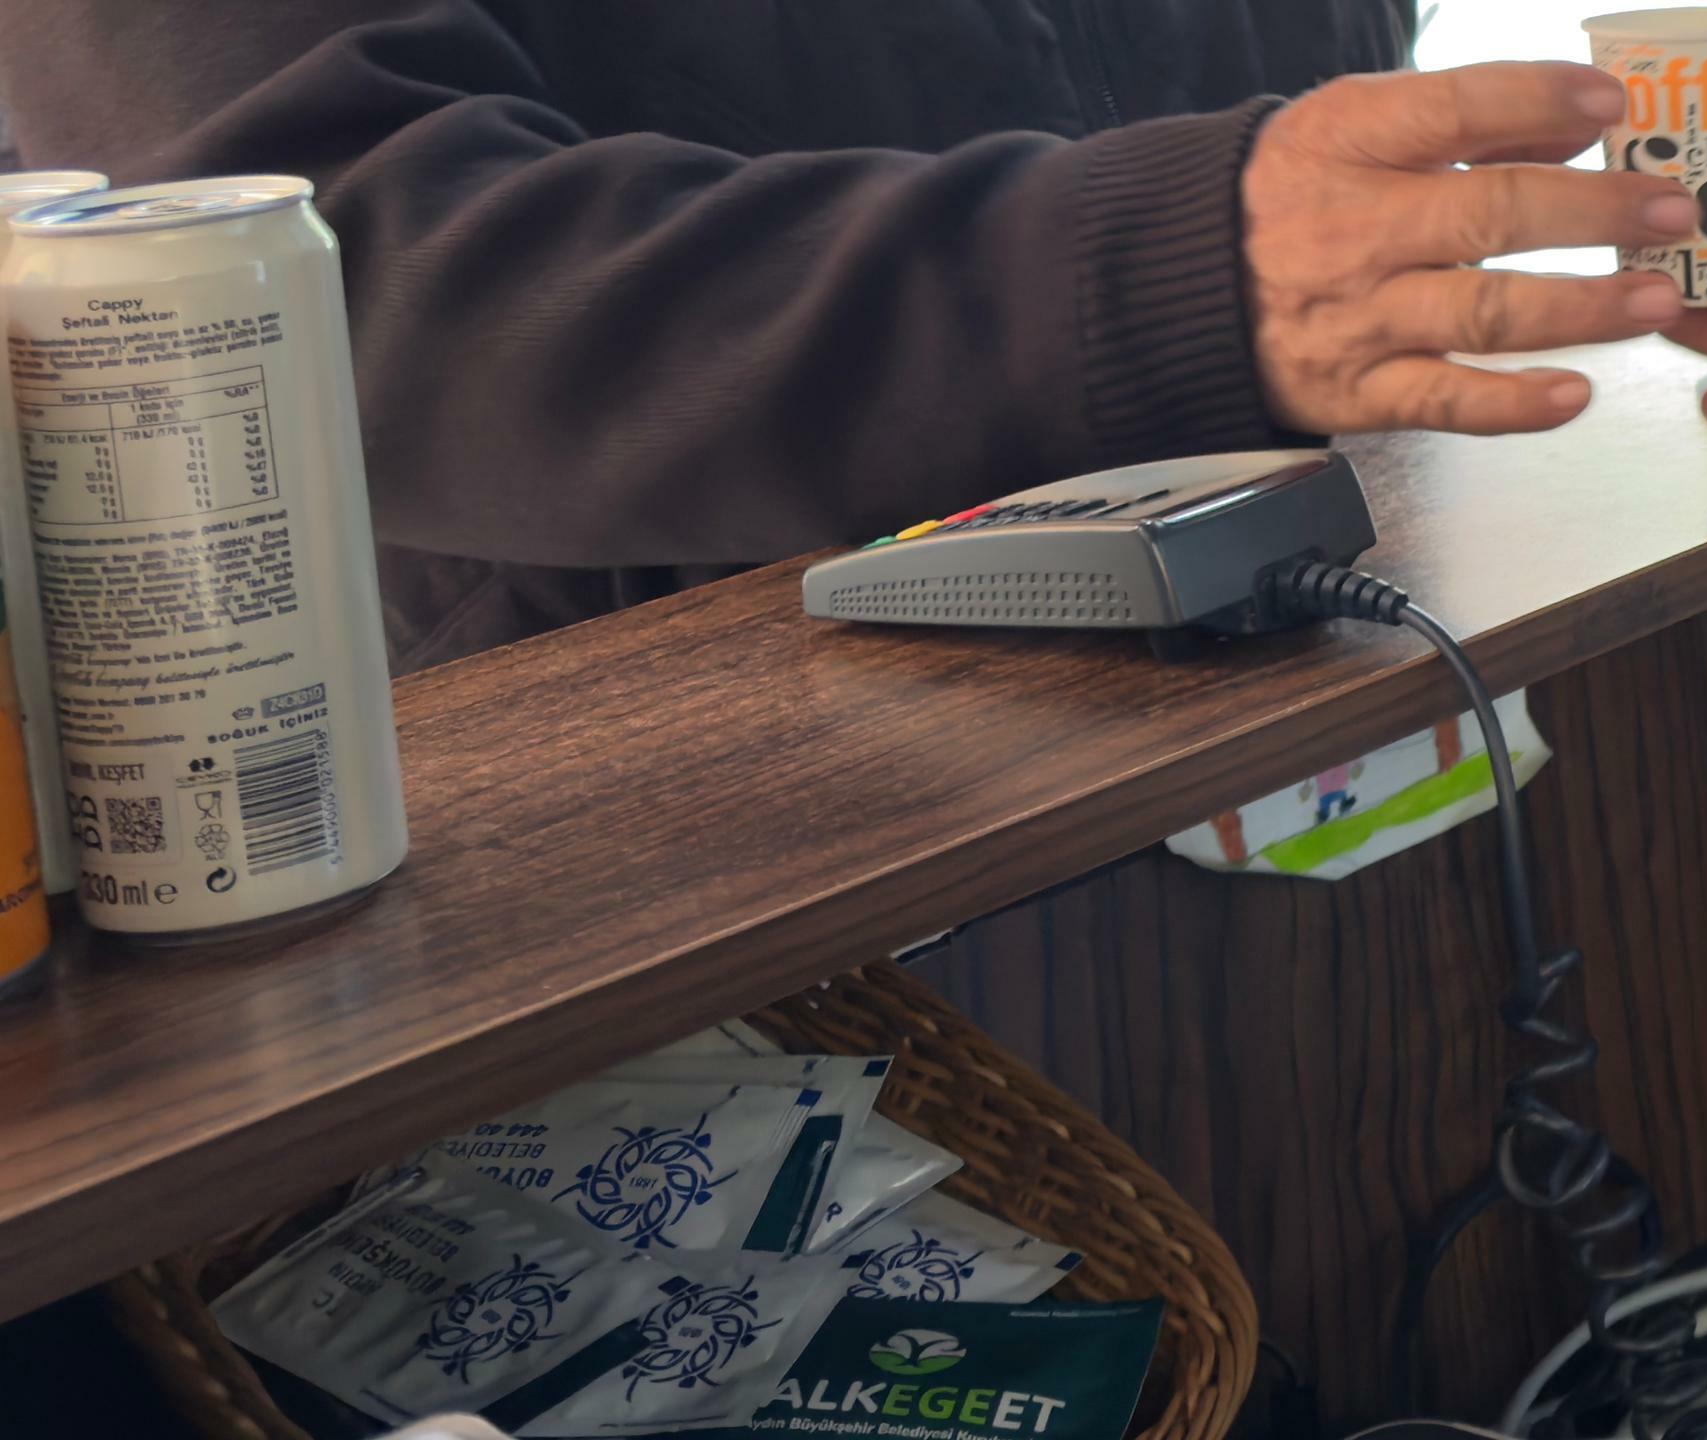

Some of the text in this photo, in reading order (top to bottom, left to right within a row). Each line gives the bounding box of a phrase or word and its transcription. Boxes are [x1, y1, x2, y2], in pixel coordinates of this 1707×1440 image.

[87, 298, 144, 312] Cappy
[758, 1377, 1066, 1433] ALKEGEET
[751, 1417, 786, 1431] ydın
